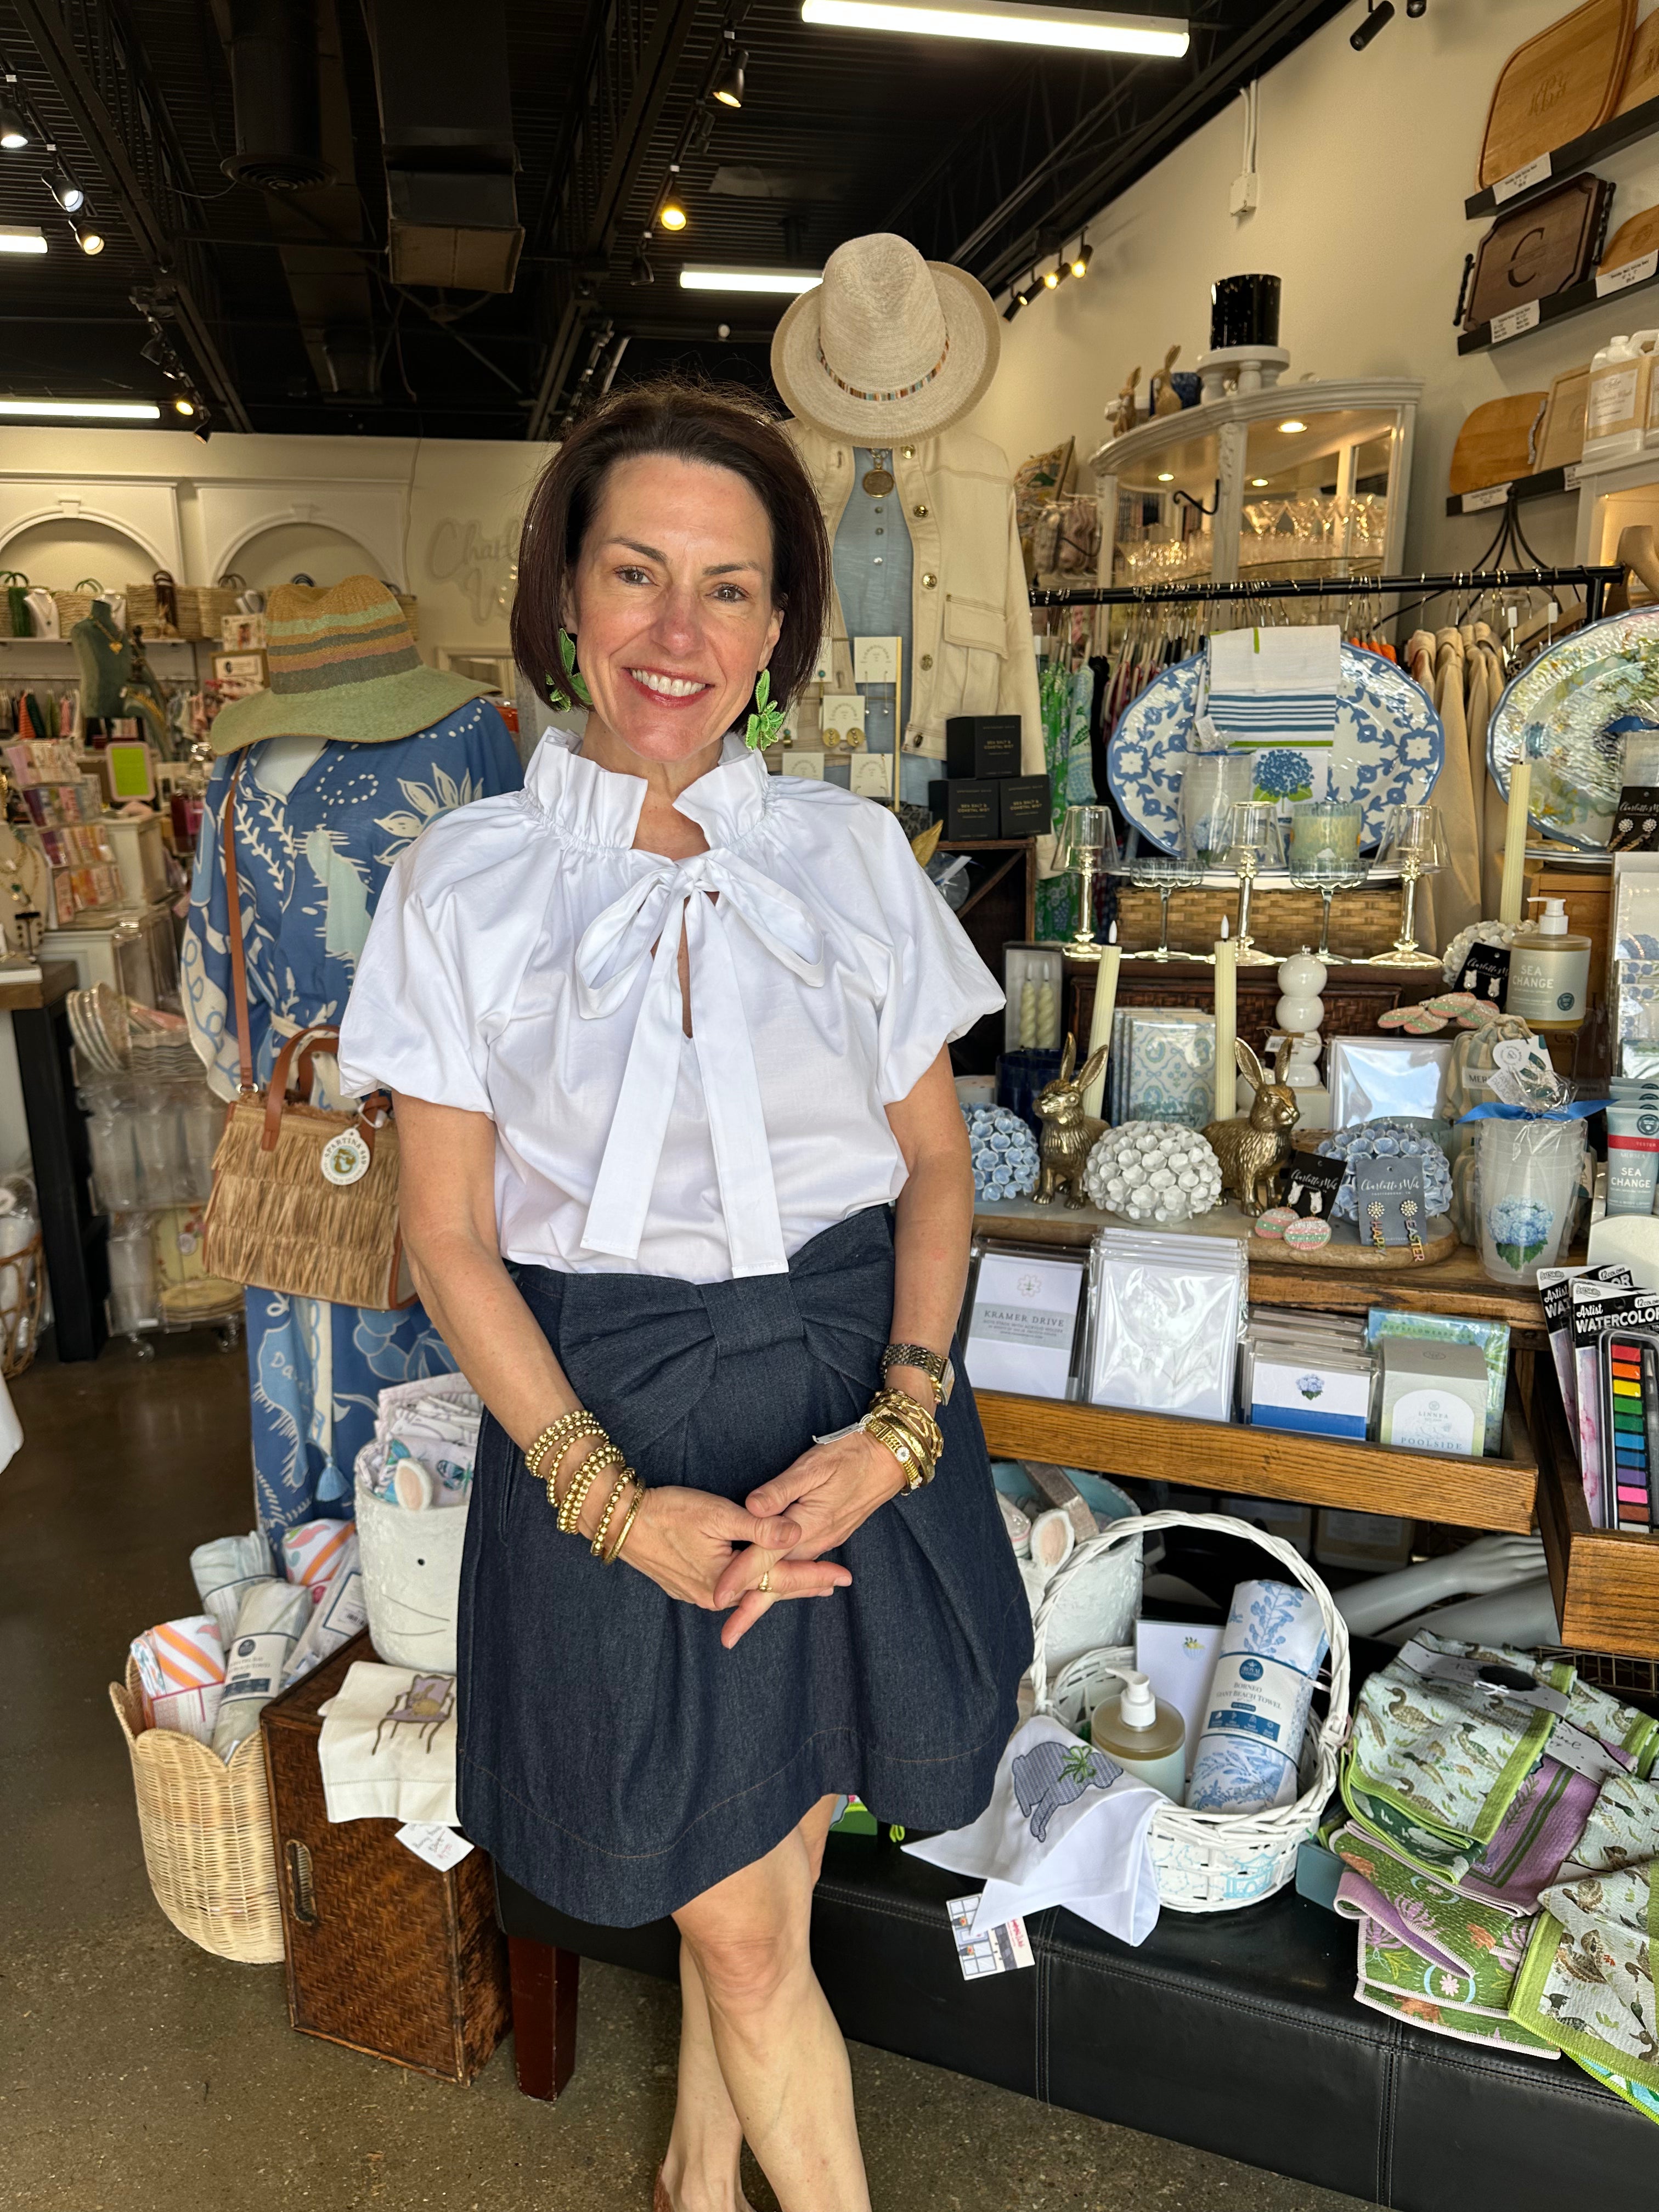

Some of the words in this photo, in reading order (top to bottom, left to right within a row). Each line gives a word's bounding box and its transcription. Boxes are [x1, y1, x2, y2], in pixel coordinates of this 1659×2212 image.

[1521, 965, 1542, 977] SEA
[1513, 975, 1554, 989] CHANGE
[1621, 1167, 1641, 1177] SEA
[1611, 1177, 1651, 1188] CHANGE
[1406, 1220, 1425, 1262] EASTER
[1600, 1271, 1607, 1279] 12
[1544, 1285, 1569, 1303] Artist
[1637, 1298, 1644, 1307] 12
[1576, 1304, 1604, 1318] Artist
[985, 1310, 1028, 1322] KRAMER
[1032, 1316, 1064, 1327] DRIVE
[1401, 1437, 1463, 1450] POOLSIDE
[1233, 1690, 1256, 1700] BEACH
[1258, 1695, 1282, 1709] TOWEL
